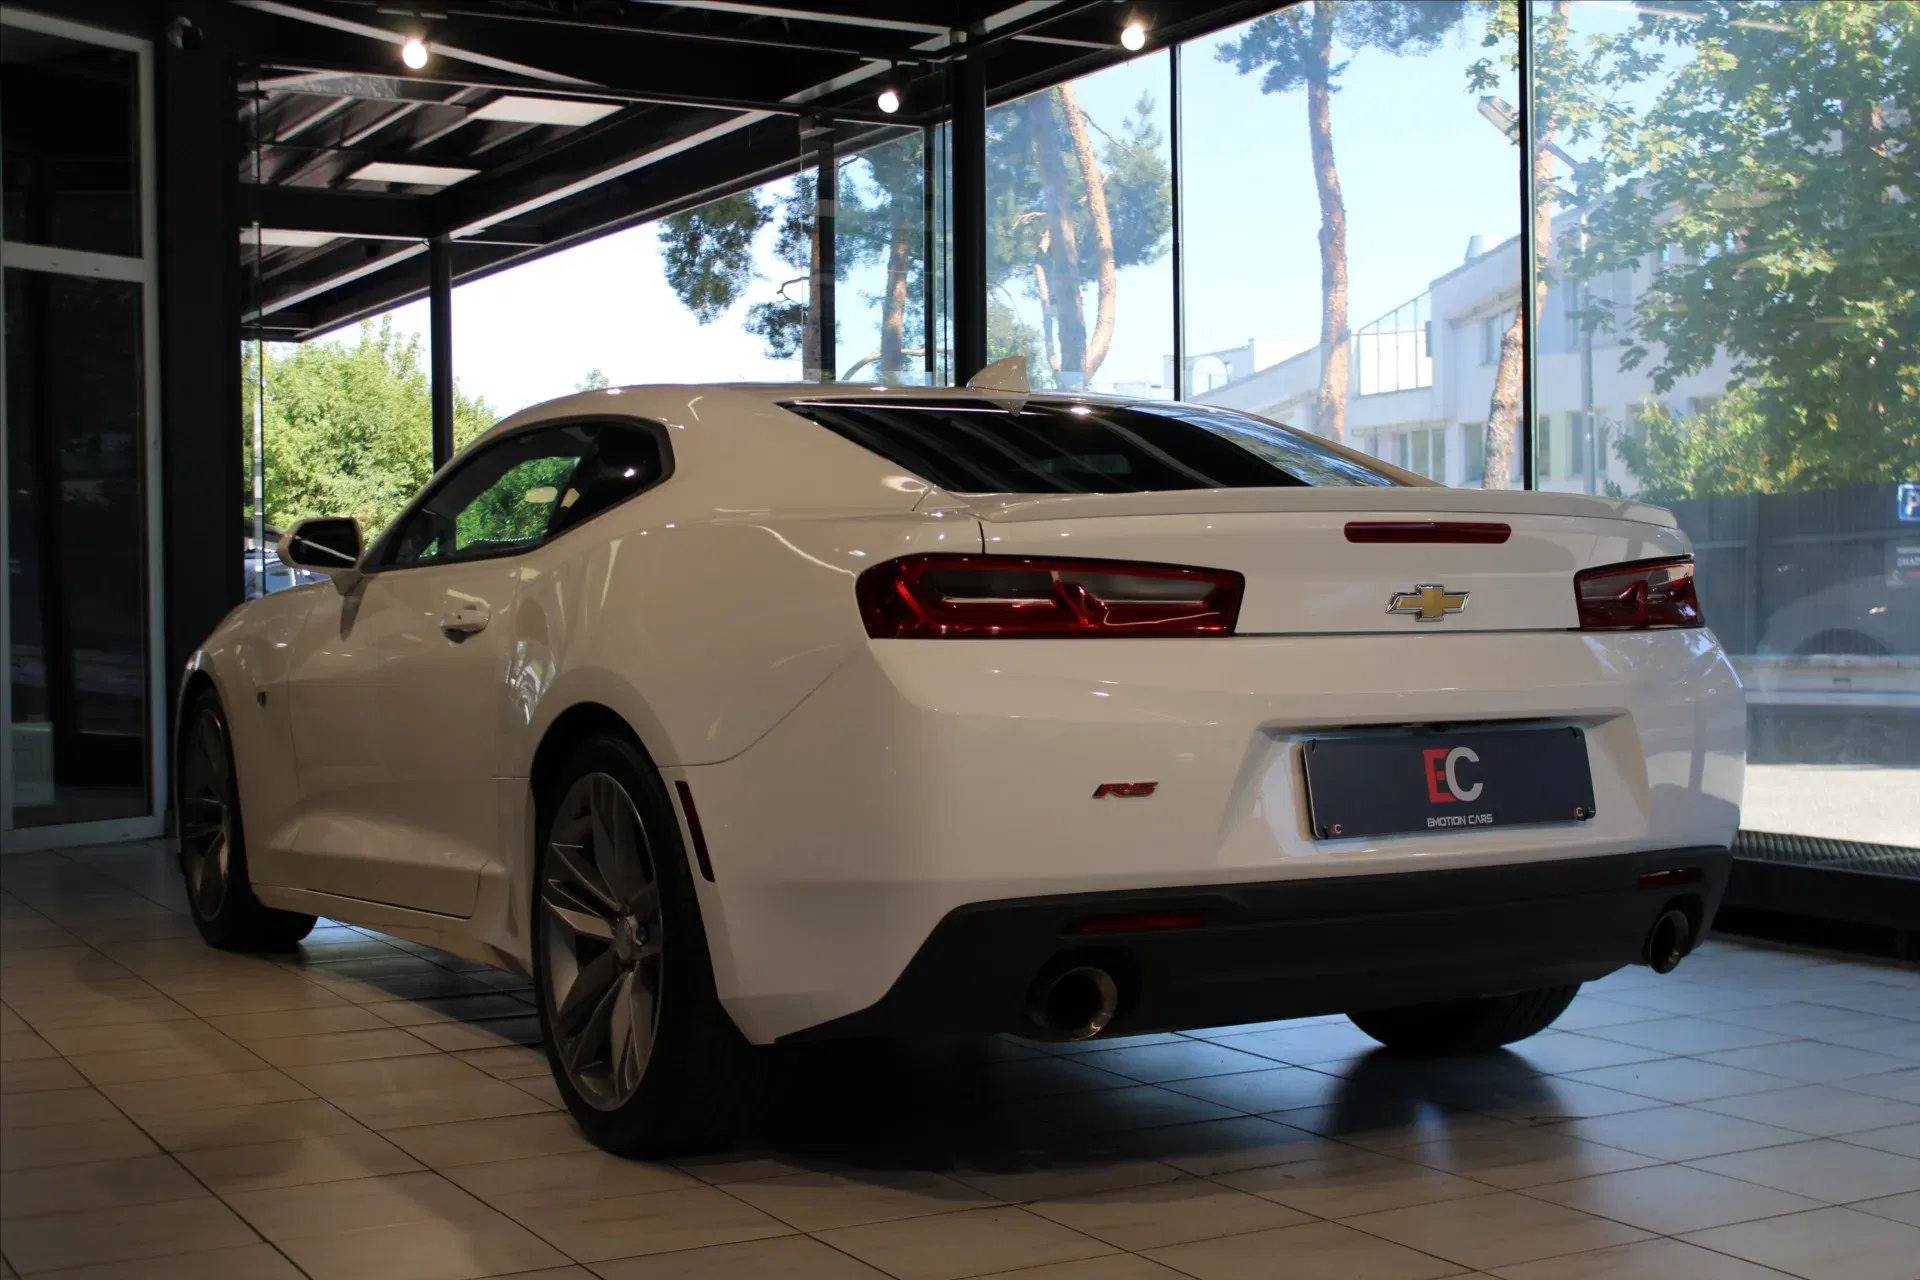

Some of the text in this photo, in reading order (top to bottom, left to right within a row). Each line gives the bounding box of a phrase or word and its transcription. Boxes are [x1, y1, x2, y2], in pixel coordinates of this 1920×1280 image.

[1906, 490, 1920, 516] P
[1423, 747, 1483, 803] EC
[1092, 782, 1158, 799] RS
[1427, 814, 1493, 827] EMOTION CARS
